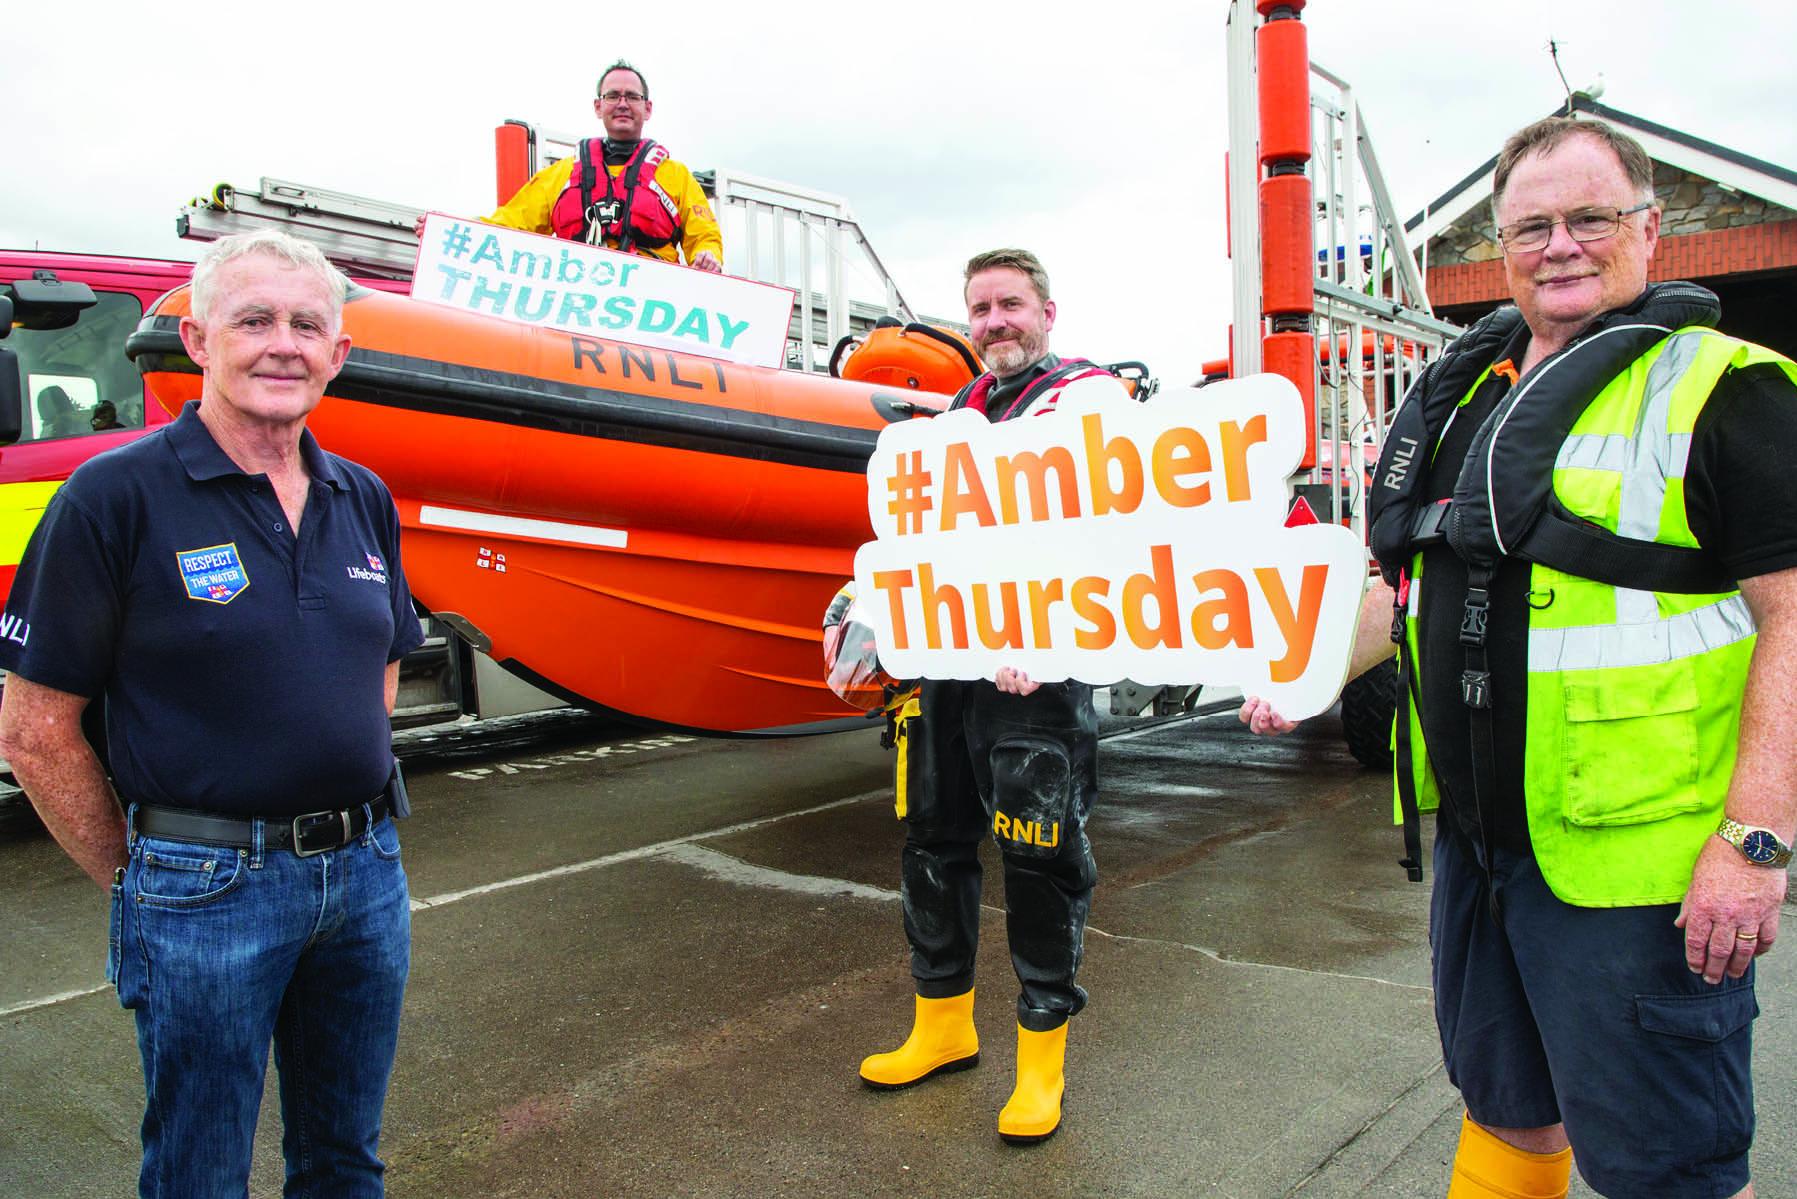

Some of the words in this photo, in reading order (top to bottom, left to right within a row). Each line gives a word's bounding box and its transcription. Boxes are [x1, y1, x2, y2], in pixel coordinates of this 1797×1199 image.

[442, 223, 640, 288] #Amber
[438, 264, 750, 350] THURSDAY
[571, 336, 727, 393] RNLI
[887, 414, 1267, 536] #Amber
[1383, 436, 1419, 490] RNLI
[184, 551, 232, 573] RESPECT
[190, 576, 210, 589] THE
[208, 570, 240, 584] WATER
[873, 545, 1329, 684] Thursday
[448, 735, 699, 780] PARKIN
[994, 810, 1059, 848] RNLI
